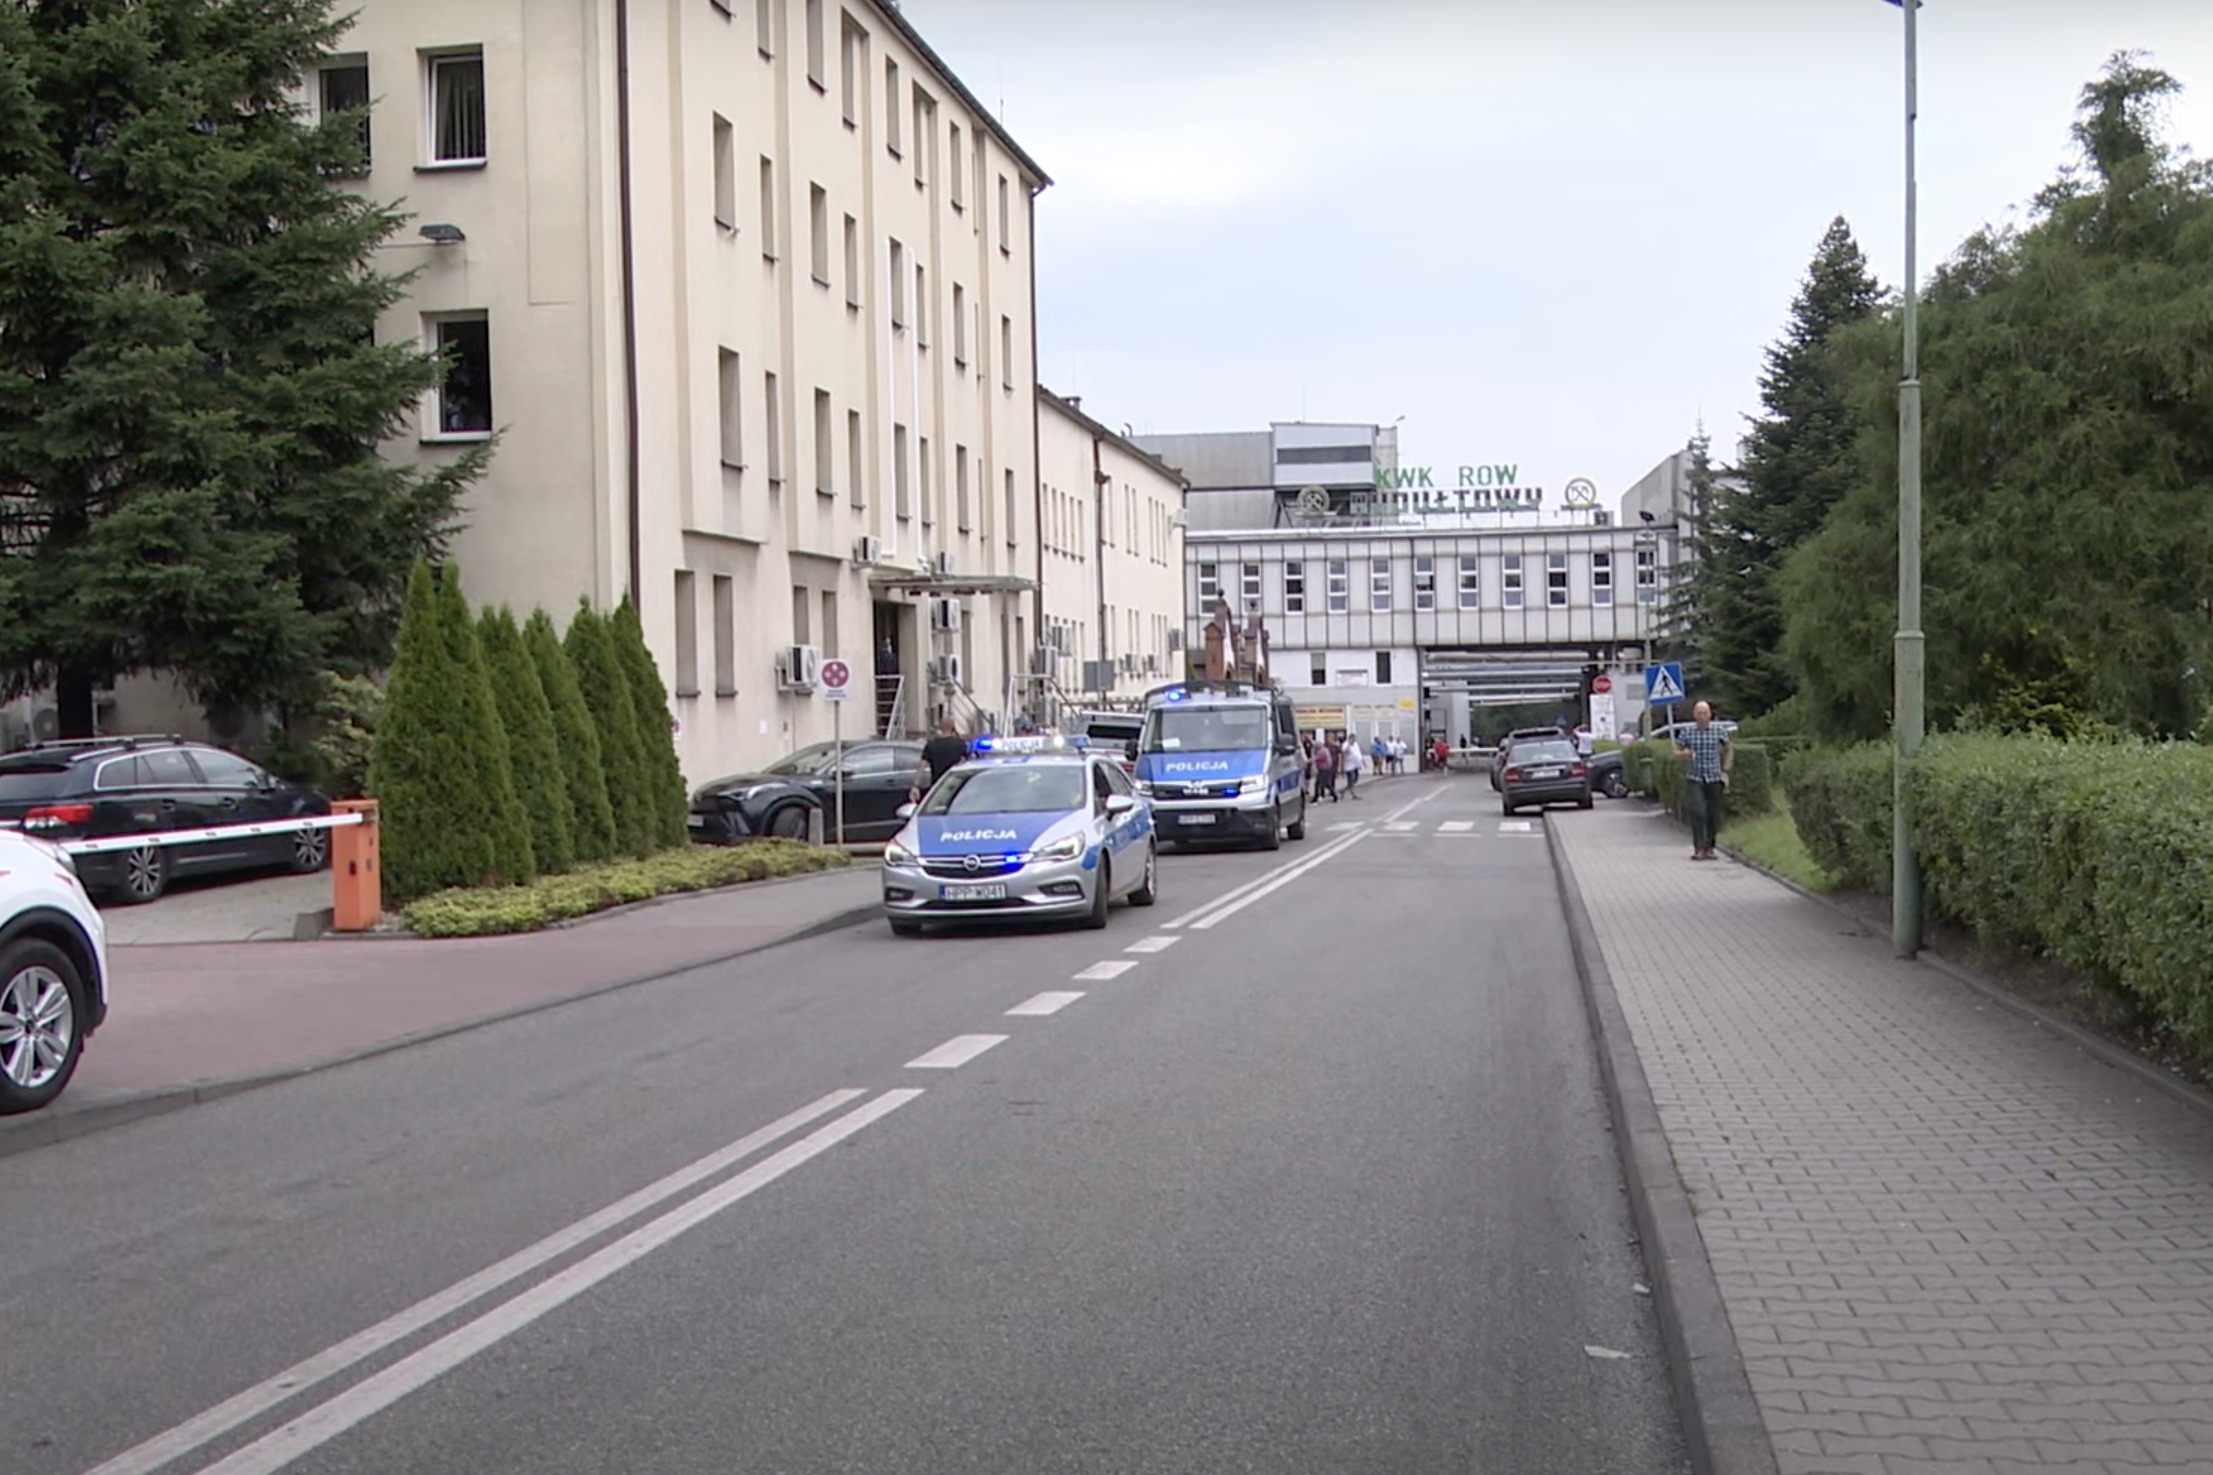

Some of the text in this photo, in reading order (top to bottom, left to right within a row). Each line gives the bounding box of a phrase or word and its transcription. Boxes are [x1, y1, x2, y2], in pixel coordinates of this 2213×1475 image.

[1377, 464, 1518, 488] KWK ROW
[1002, 739, 1043, 750] POLICJA
[1166, 761, 1228, 773] POLICJA
[941, 829, 1017, 842] POLICJA
